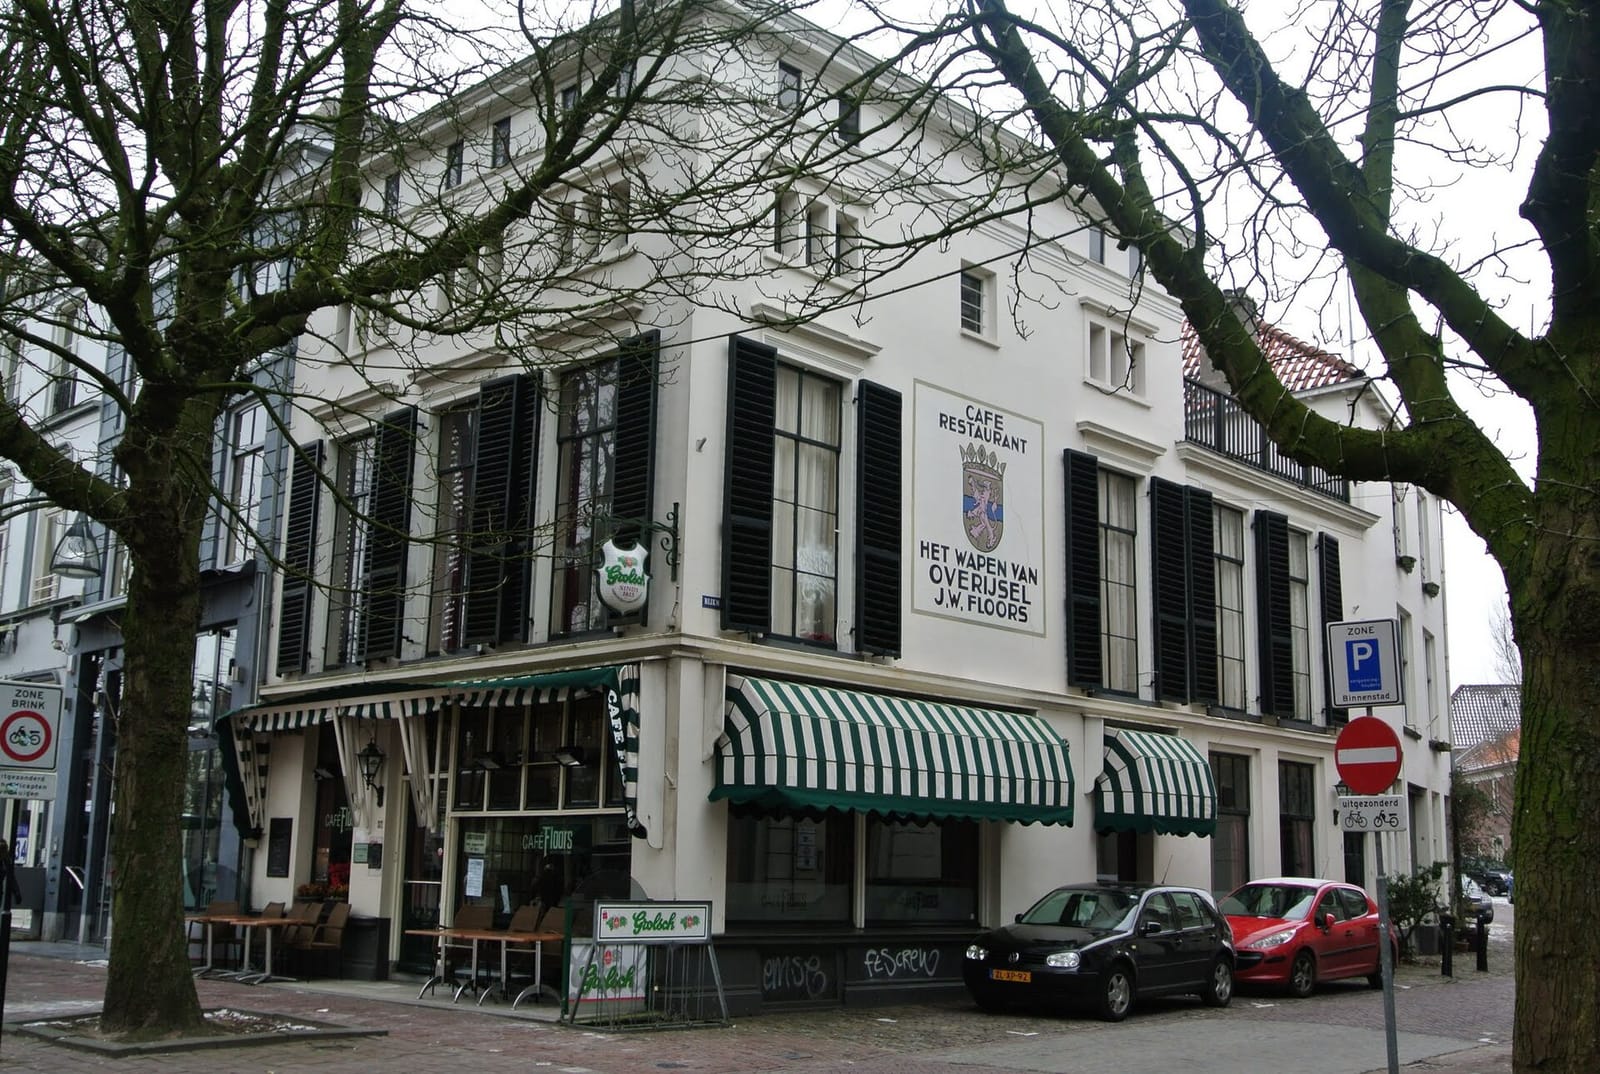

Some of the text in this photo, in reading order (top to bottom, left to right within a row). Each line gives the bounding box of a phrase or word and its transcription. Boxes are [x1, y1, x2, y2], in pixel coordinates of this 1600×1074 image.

[965, 405, 1004, 431] CAFE
[939, 412, 1028, 454] RESTAURANT
[920, 540, 1038, 586] HET WAPEN VAN
[929, 564, 1031, 606] OVERIJSEL
[934, 587, 1028, 624] J.W. FLOORS
[1347, 626, 1375, 636] ZONE
[1352, 642, 1373, 671] P
[12, 699, 45, 710] BRINK
[15, 689, 44, 700] ZONE
[1342, 692, 1390, 703] Binnenstad
[1342, 799, 1399, 810] uitgezonderd
[632, 910, 677, 935] Grolsch
